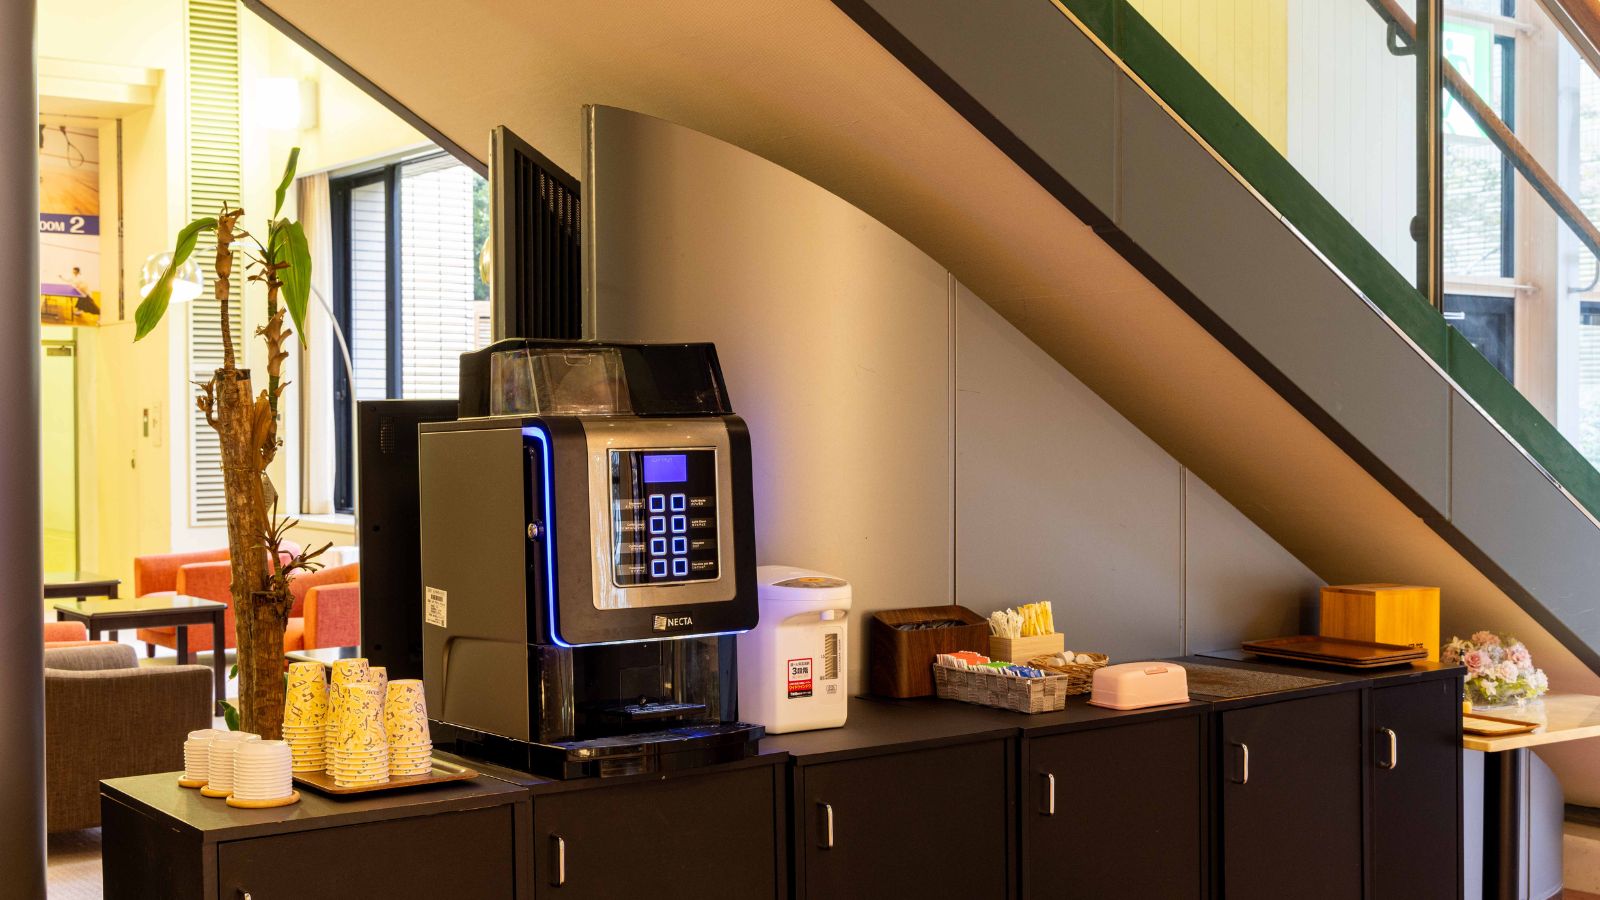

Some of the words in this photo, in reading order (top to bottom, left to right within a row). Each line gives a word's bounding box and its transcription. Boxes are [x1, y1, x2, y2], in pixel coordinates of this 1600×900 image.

[40, 220, 65, 232] OOM
[69, 216, 85, 234] 2
[667, 616, 693, 627] NECTA
